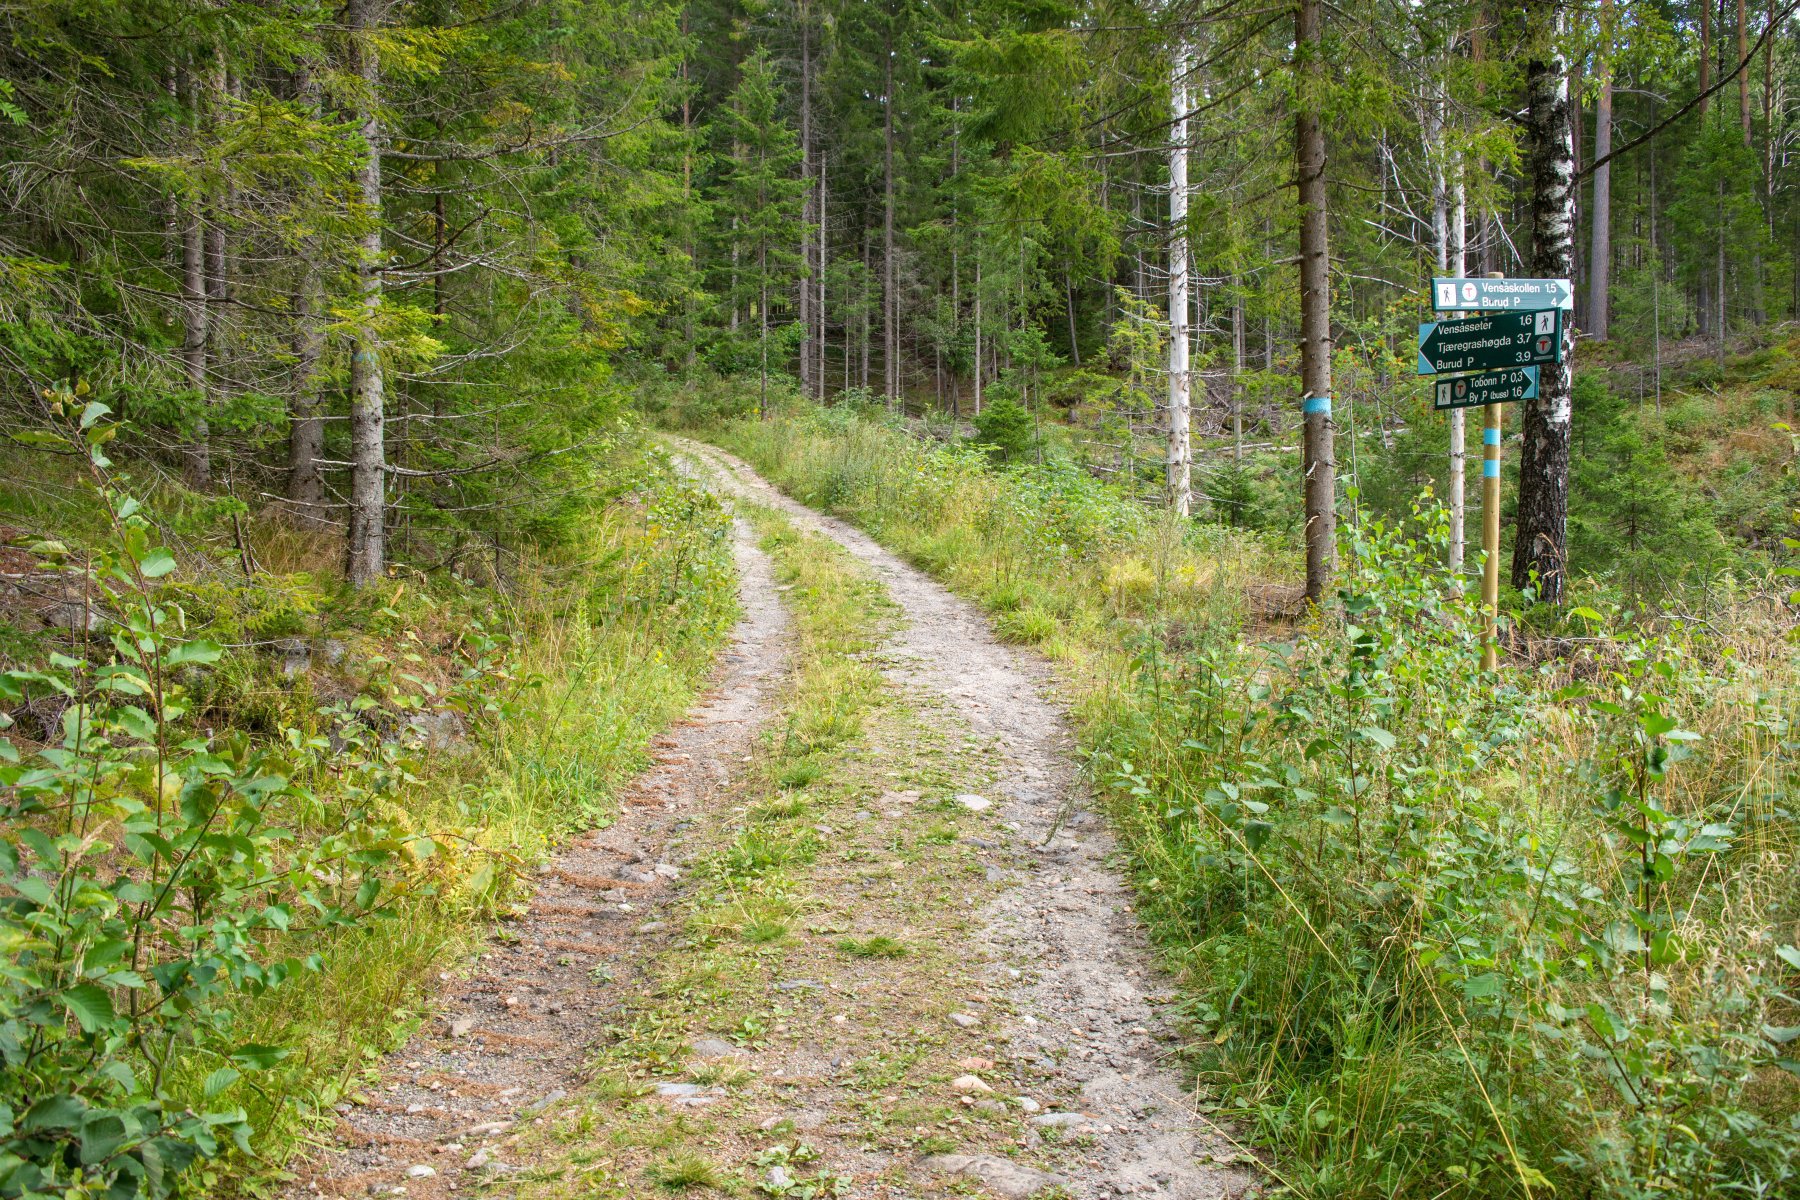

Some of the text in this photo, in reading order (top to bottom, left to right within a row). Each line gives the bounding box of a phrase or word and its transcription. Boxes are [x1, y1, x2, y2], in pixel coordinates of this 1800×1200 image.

[1482, 296, 1557, 307] Burud P 4
[1438, 315, 1533, 335] Vensåsseter 1,6
[1437, 332, 1532, 354] Tjæregrashøgda 3,7
[1437, 351, 1531, 370] Burud P 3,9
[1501, 374, 1507, 384] P
[1510, 371, 1523, 384] 0,3
[1469, 386, 1523, 403] By P (buss) 1,6
